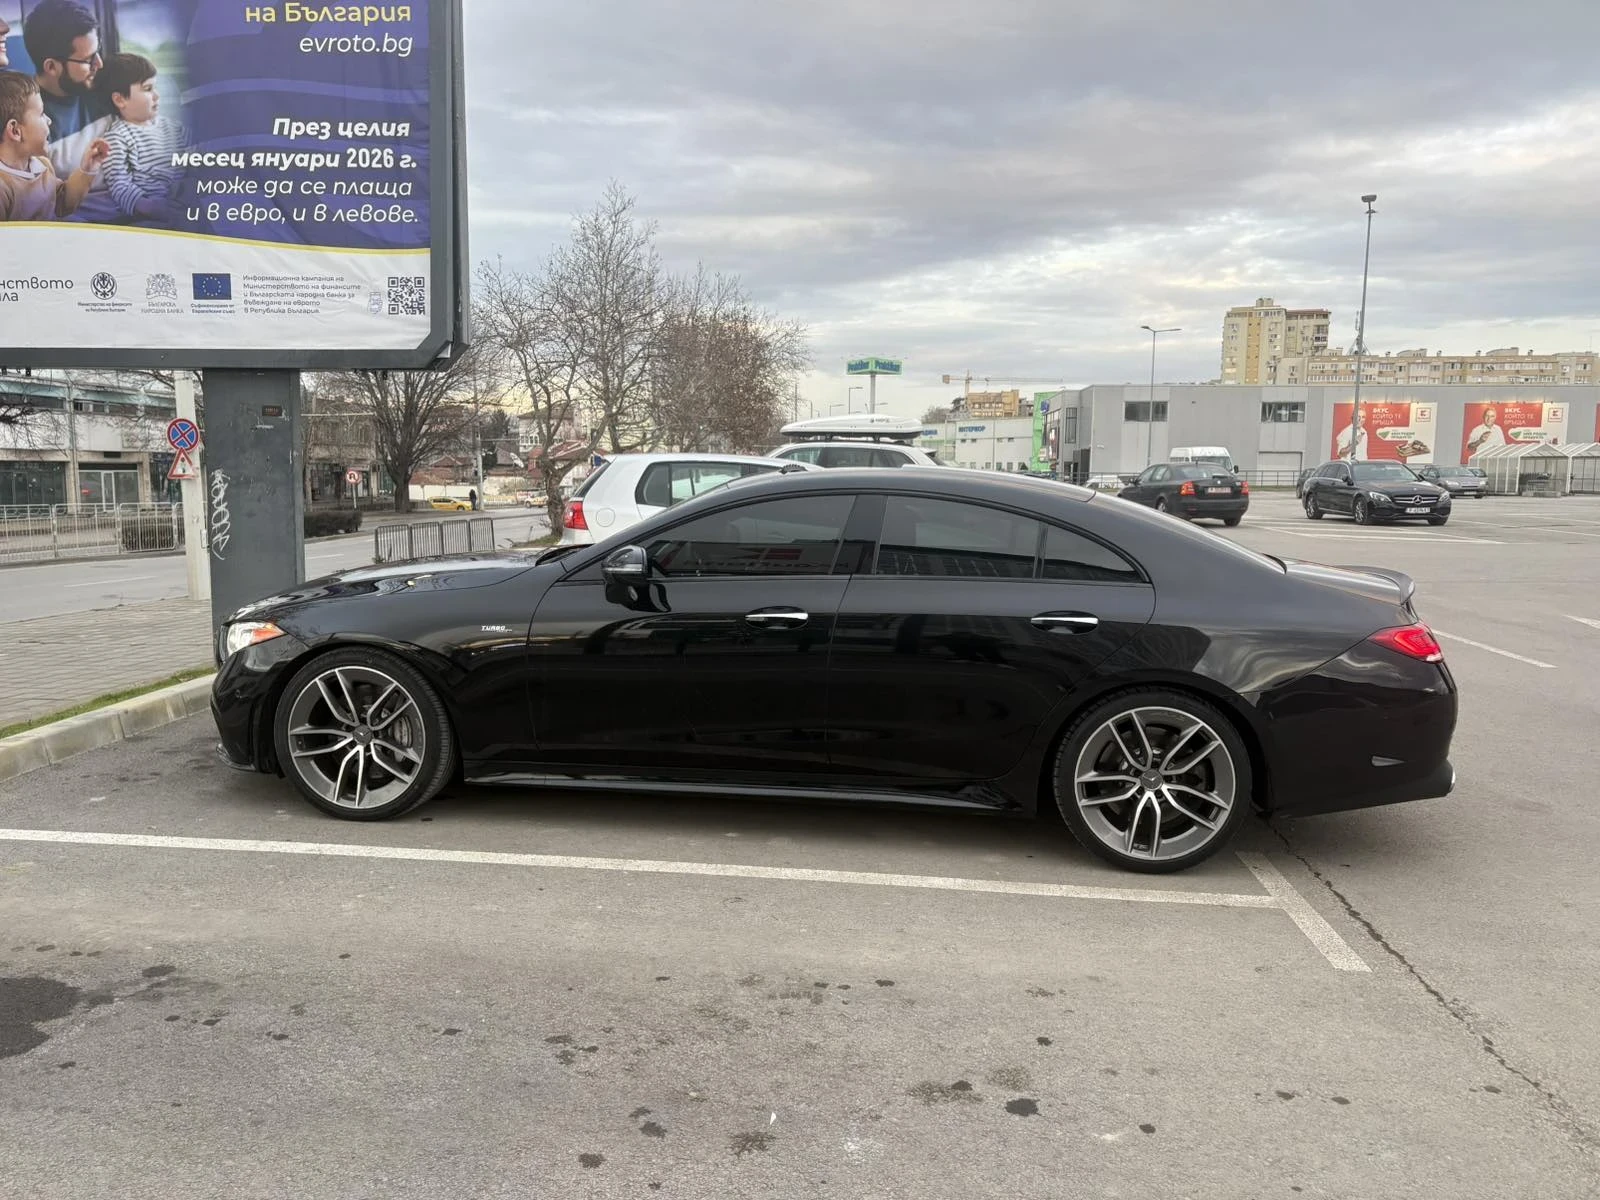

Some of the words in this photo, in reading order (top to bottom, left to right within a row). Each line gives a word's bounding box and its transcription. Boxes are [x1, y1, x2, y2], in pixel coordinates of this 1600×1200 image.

[245, 6, 276, 22] на
[285, 2, 412, 26] България
[299, 33, 413, 57] evroto.bg
[272, 118, 331, 139] През
[338, 122, 410, 138] целия
[171, 152, 245, 168] месец
[251, 153, 340, 171] януари
[346, 148, 394, 168] 2026
[399, 154, 417, 168] г.
[196, 176, 258, 195] може
[264, 181, 293, 197] да
[300, 181, 327, 195] се
[333, 181, 413, 198] плаща
[186, 207, 199, 221] и
[206, 203, 220, 221] в
[226, 203, 286, 225] евро,
[293, 208, 306, 222] и
[314, 203, 327, 222] в
[332, 205, 418, 223] левове.
[0, 292, 19, 301] ла
